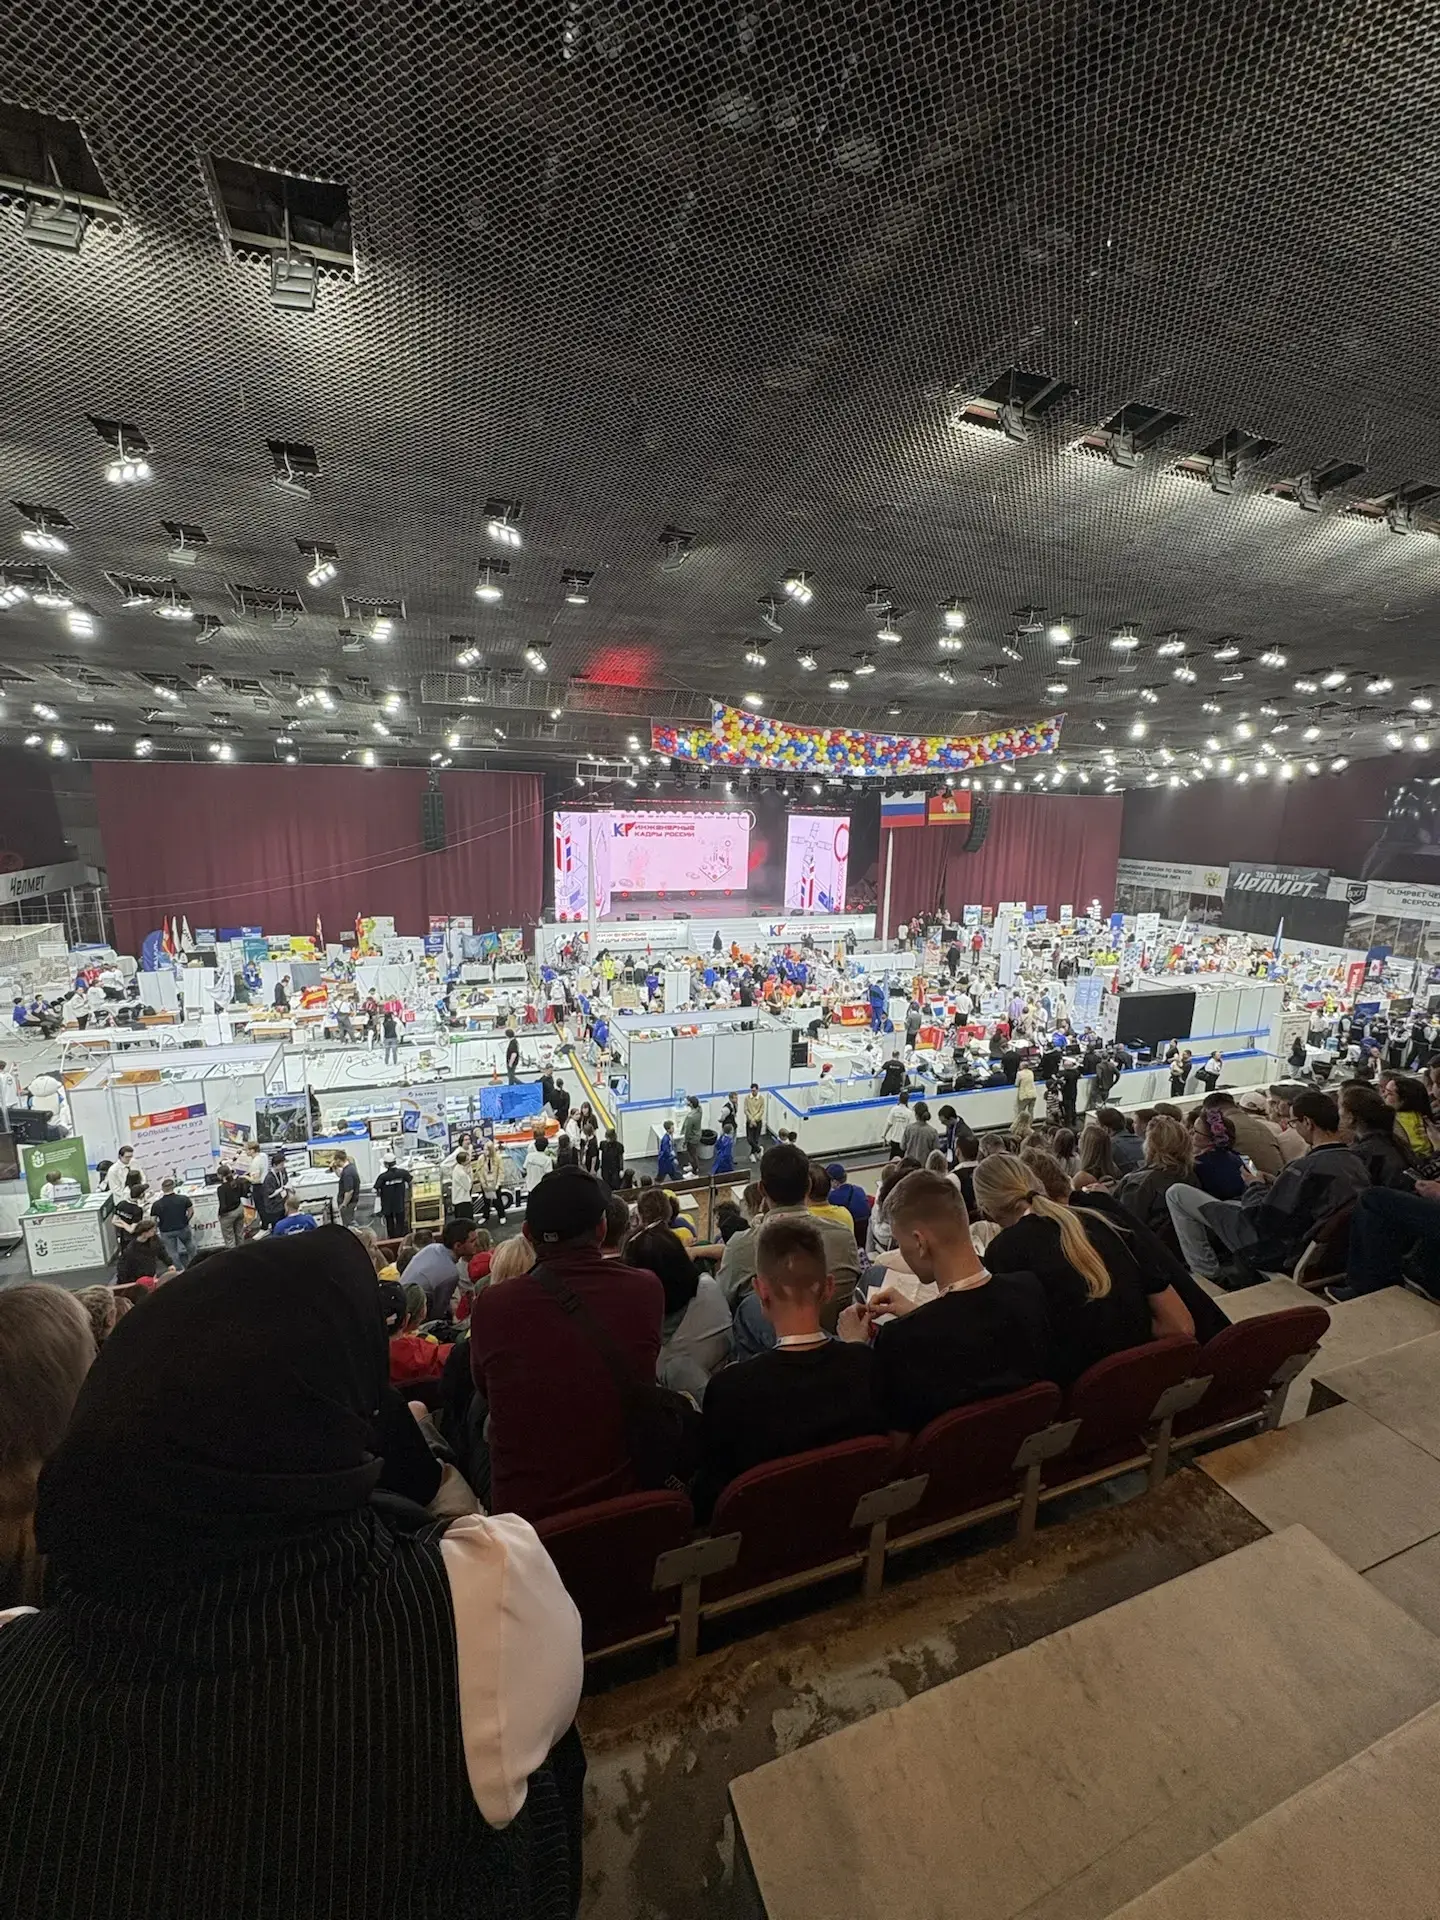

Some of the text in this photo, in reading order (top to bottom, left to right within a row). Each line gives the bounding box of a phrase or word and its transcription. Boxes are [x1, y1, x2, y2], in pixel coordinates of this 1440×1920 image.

[1255, 871, 1300, 882] ЗДЕСЬ ИГРАЕТ
[1428, 891, 1440, 899] ЧЕ
[137, 1127, 170, 1139] БОЛЬШЕ
[171, 1123, 188, 1132] ЧЕМ
[189, 1119, 203, 1128] ВУЗ
